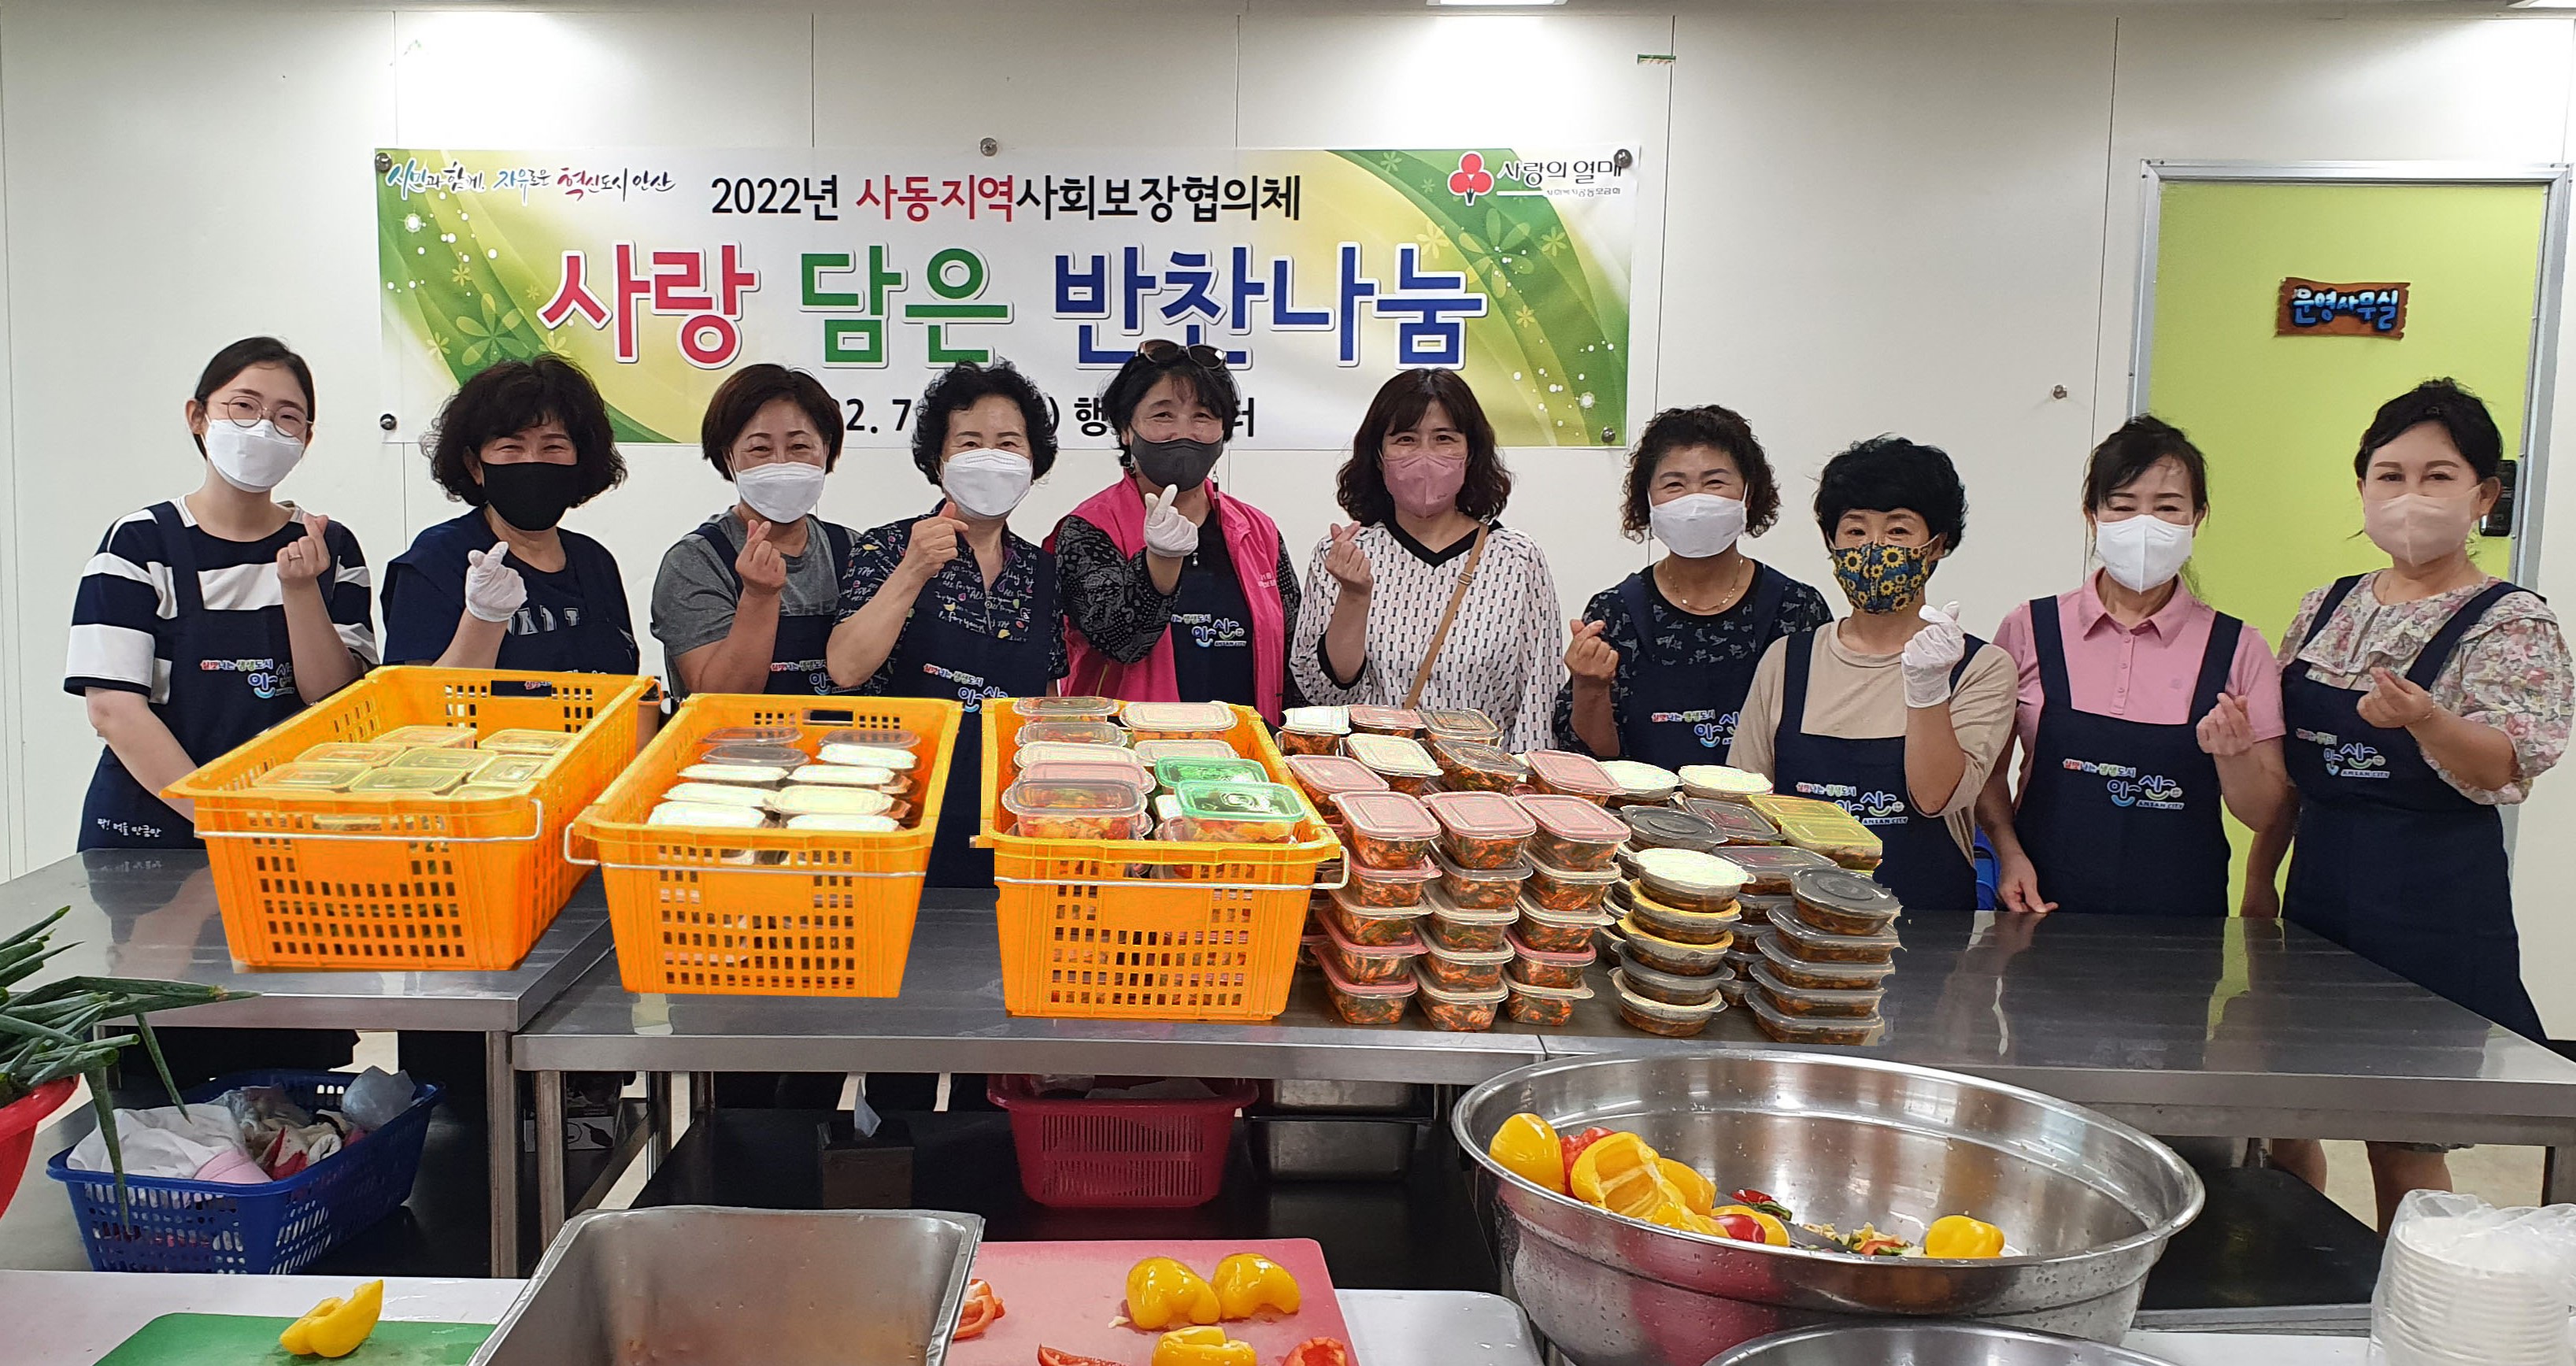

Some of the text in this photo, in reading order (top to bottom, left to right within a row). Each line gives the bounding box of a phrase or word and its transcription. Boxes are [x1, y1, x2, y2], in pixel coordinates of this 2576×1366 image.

[387, 159, 442, 199] 시민과
[493, 168, 552, 205] 자유로운
[557, 166, 628, 202] 혁신도시
[632, 170, 677, 194] 안산
[1498, 160, 1623, 186] 사랑의 열매
[710, 174, 1301, 223] 2022년 사동지역사회보장협의체
[543, 245, 1482, 365] 사랑 담은 반찬나눔
[2293, 287, 2399, 331] 운영사무실
